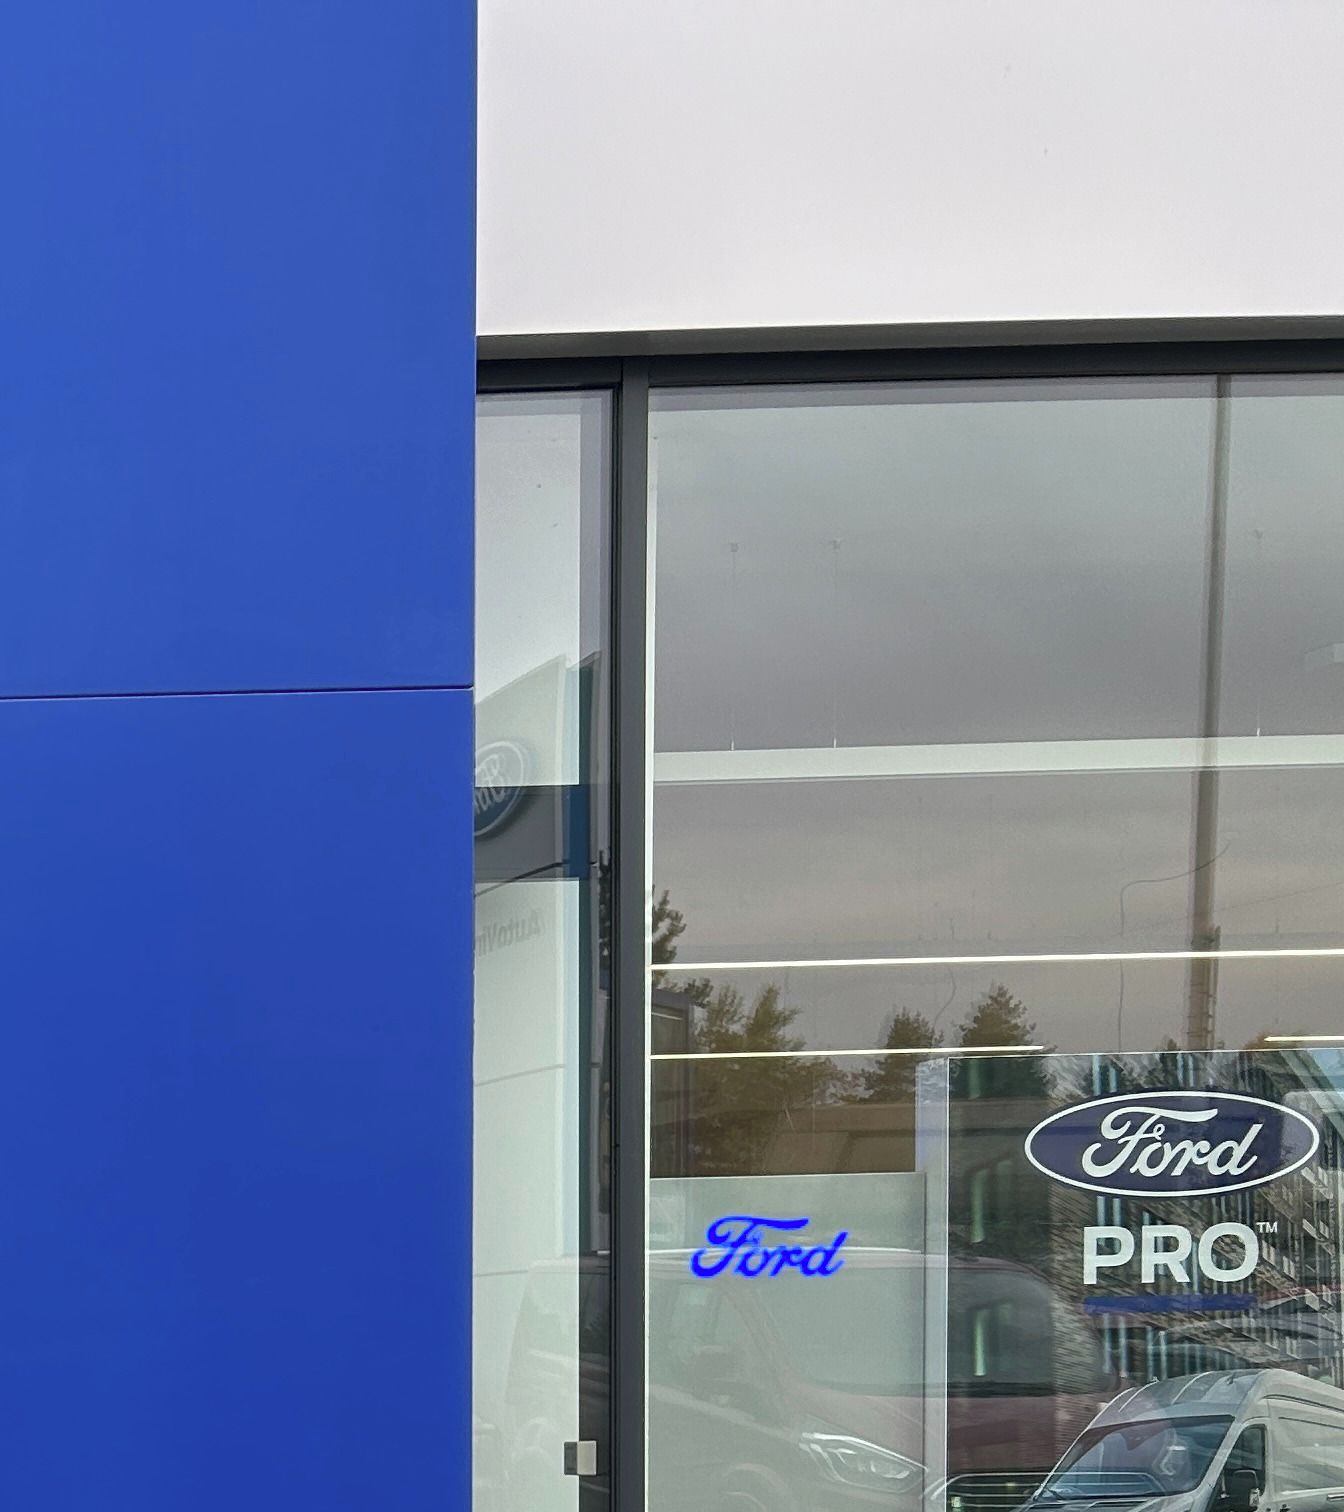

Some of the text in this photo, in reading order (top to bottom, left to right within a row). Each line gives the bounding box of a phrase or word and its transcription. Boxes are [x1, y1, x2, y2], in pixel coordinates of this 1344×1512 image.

[1082, 1107, 1263, 1178] Ford
[691, 1215, 847, 1279] Ford
[1083, 1222, 1259, 1285] PRO
